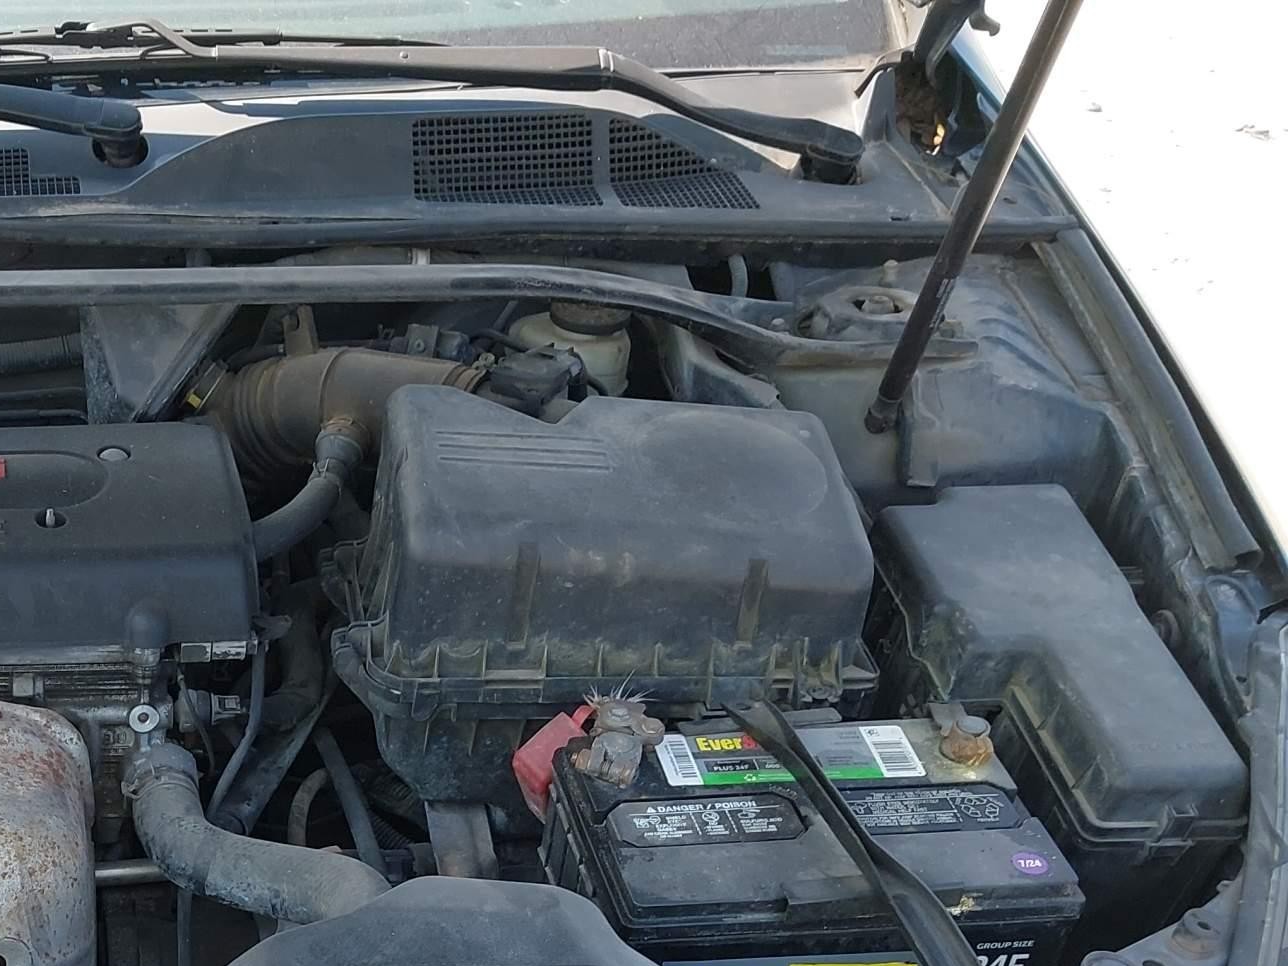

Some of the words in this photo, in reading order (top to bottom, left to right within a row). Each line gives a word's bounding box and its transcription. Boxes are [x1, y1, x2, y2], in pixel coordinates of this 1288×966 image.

[657, 803, 704, 813] DANGER
[715, 800, 757, 810] POISON
[975, 941, 1012, 950] GROUP
[1012, 939, 1035, 948] SIZE
